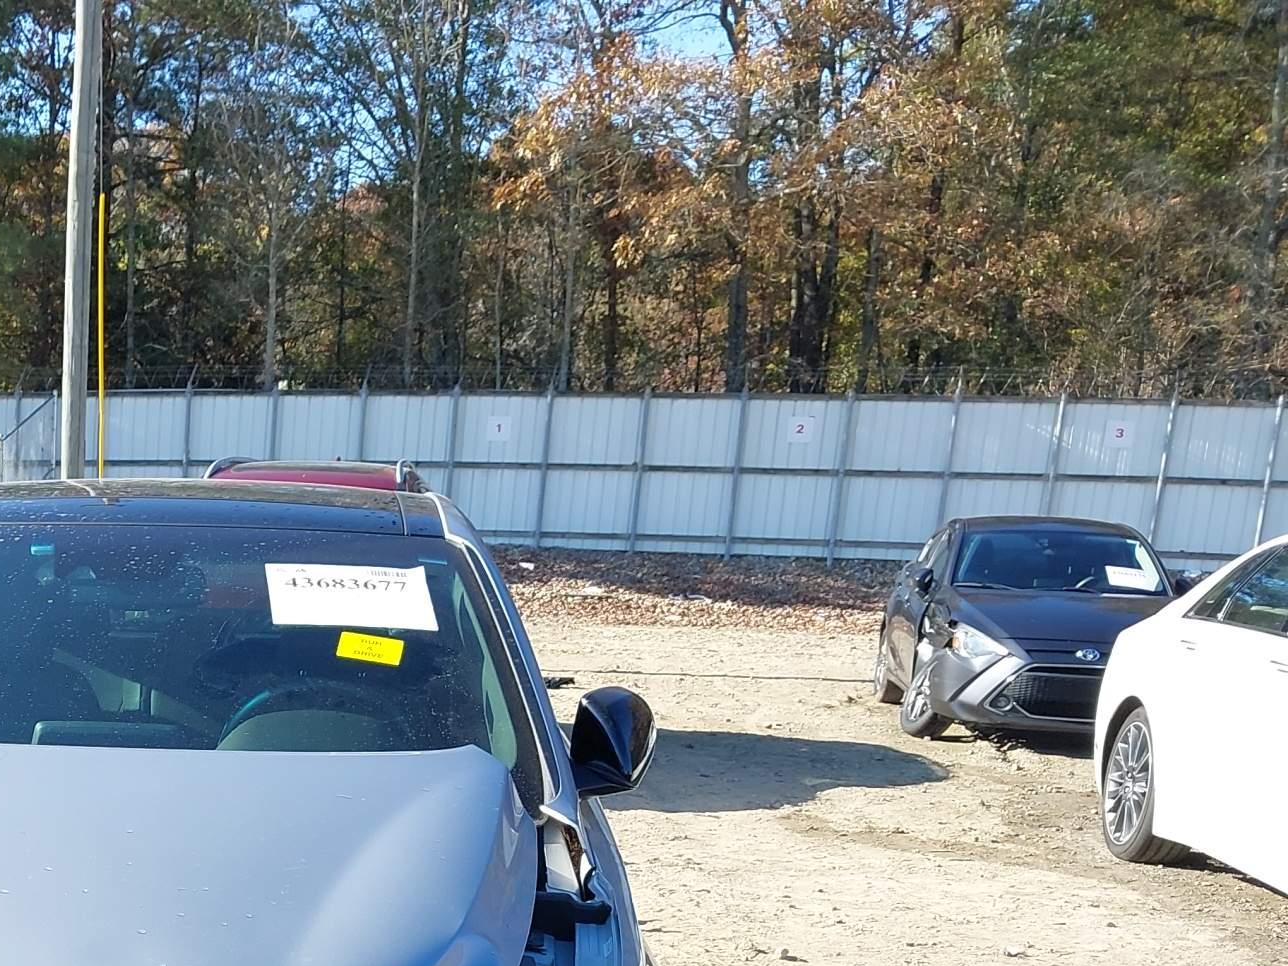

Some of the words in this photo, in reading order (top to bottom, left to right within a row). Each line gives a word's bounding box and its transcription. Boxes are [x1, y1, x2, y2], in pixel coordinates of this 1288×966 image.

[495, 423, 502, 433] 1
[795, 424, 804, 434] 2
[1115, 428, 1124, 438] 3
[284, 577, 408, 592] 43683677
